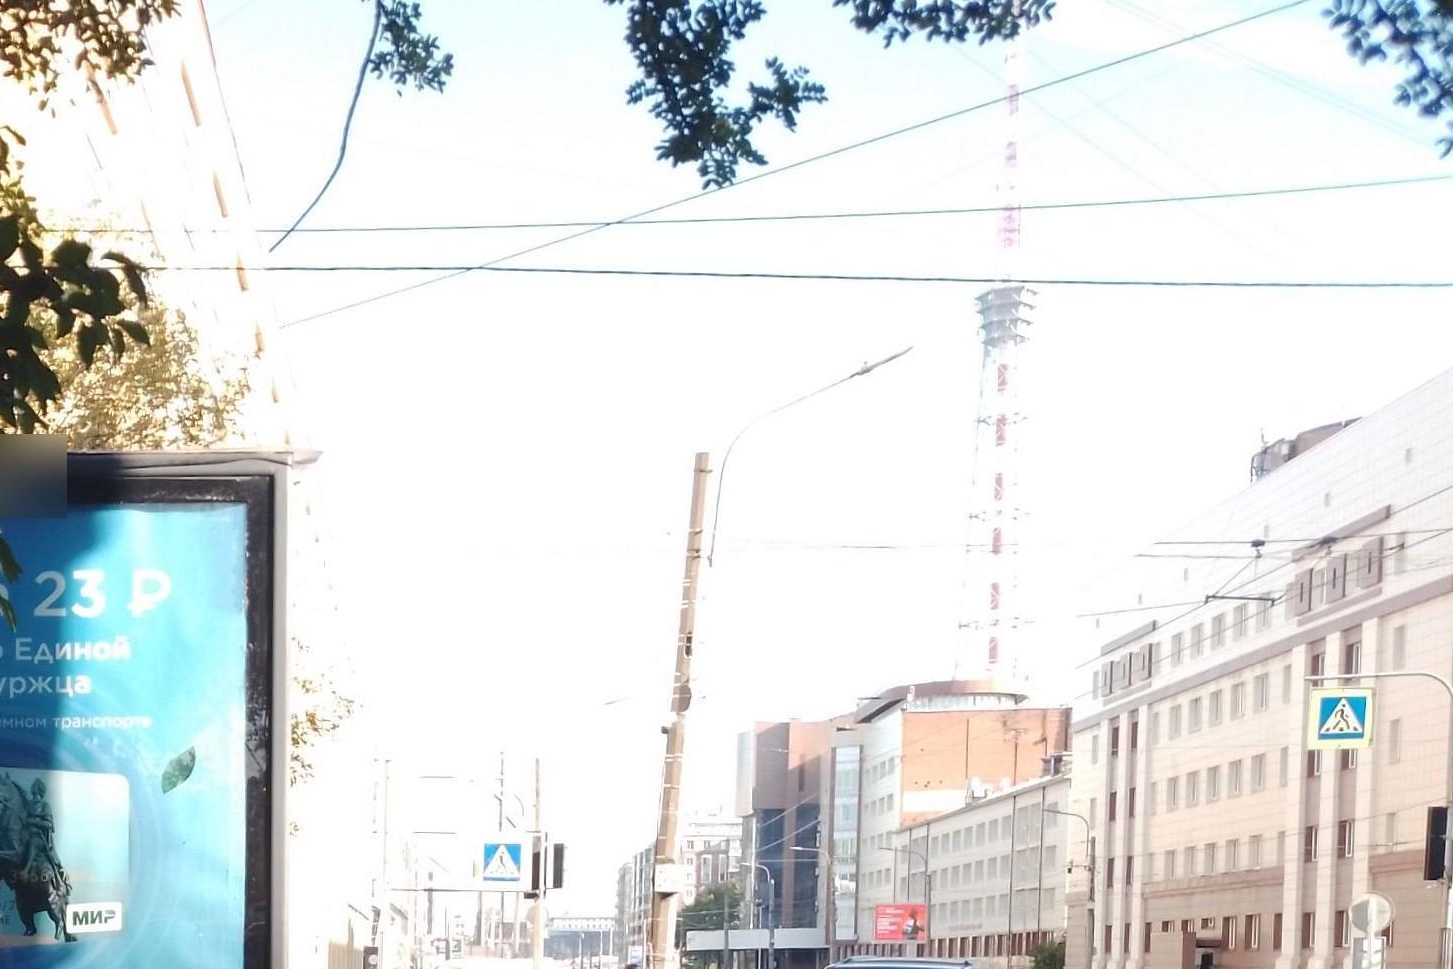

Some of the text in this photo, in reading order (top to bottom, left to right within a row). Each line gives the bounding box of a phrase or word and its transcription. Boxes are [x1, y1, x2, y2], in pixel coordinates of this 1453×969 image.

[33, 569, 107, 618] 23
[15, 634, 132, 666] Единой
[53, 716, 152, 732] транспорте
[72, 908, 116, 927] МИР
